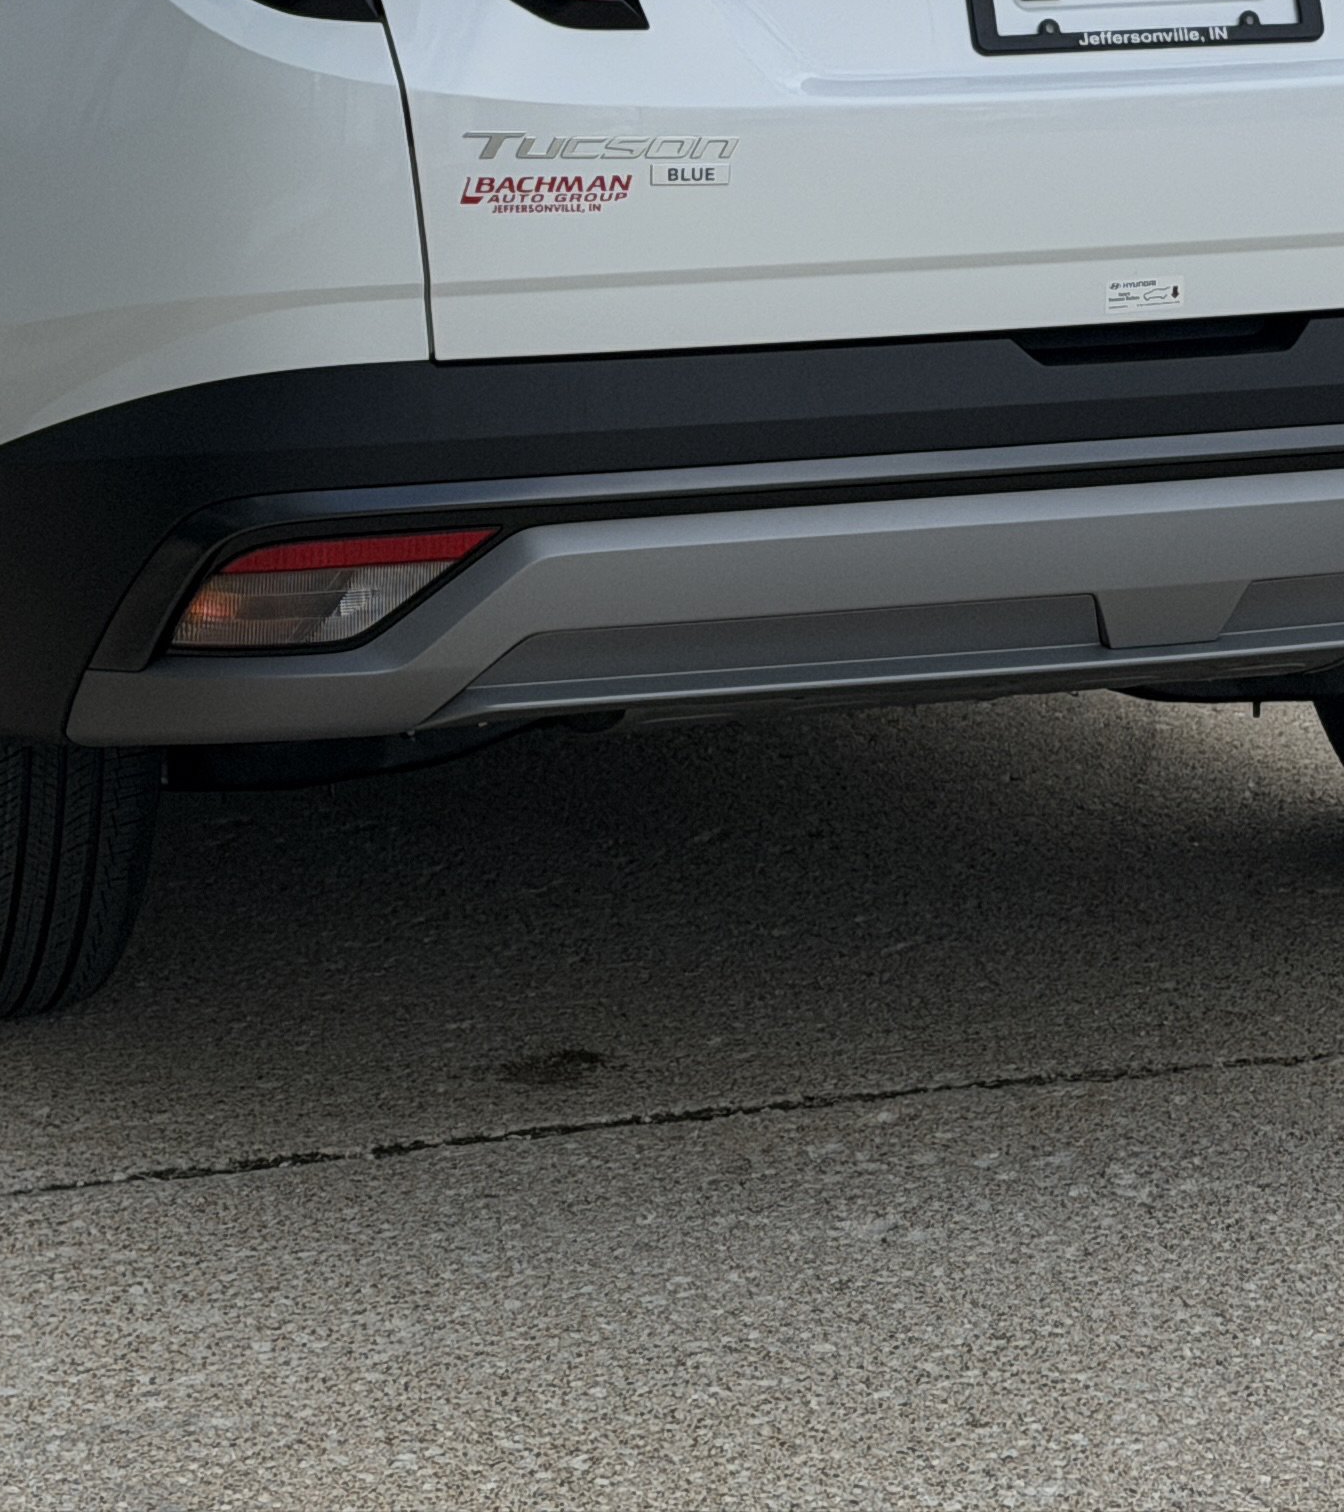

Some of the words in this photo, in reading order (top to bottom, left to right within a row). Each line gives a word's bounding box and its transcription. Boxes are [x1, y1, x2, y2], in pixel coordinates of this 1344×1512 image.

[1079, 27, 1205, 46] Jeffersonville,
[1209, 25, 1229, 40] IN
[667, 168, 715, 182] BLUE
[474, 174, 633, 193] BACHMAN
[487, 193, 544, 204] AUTO
[554, 192, 628, 204] GROUP
[492, 204, 586, 214] JEFFERSONVILLE,
[589, 203, 602, 213] IN
